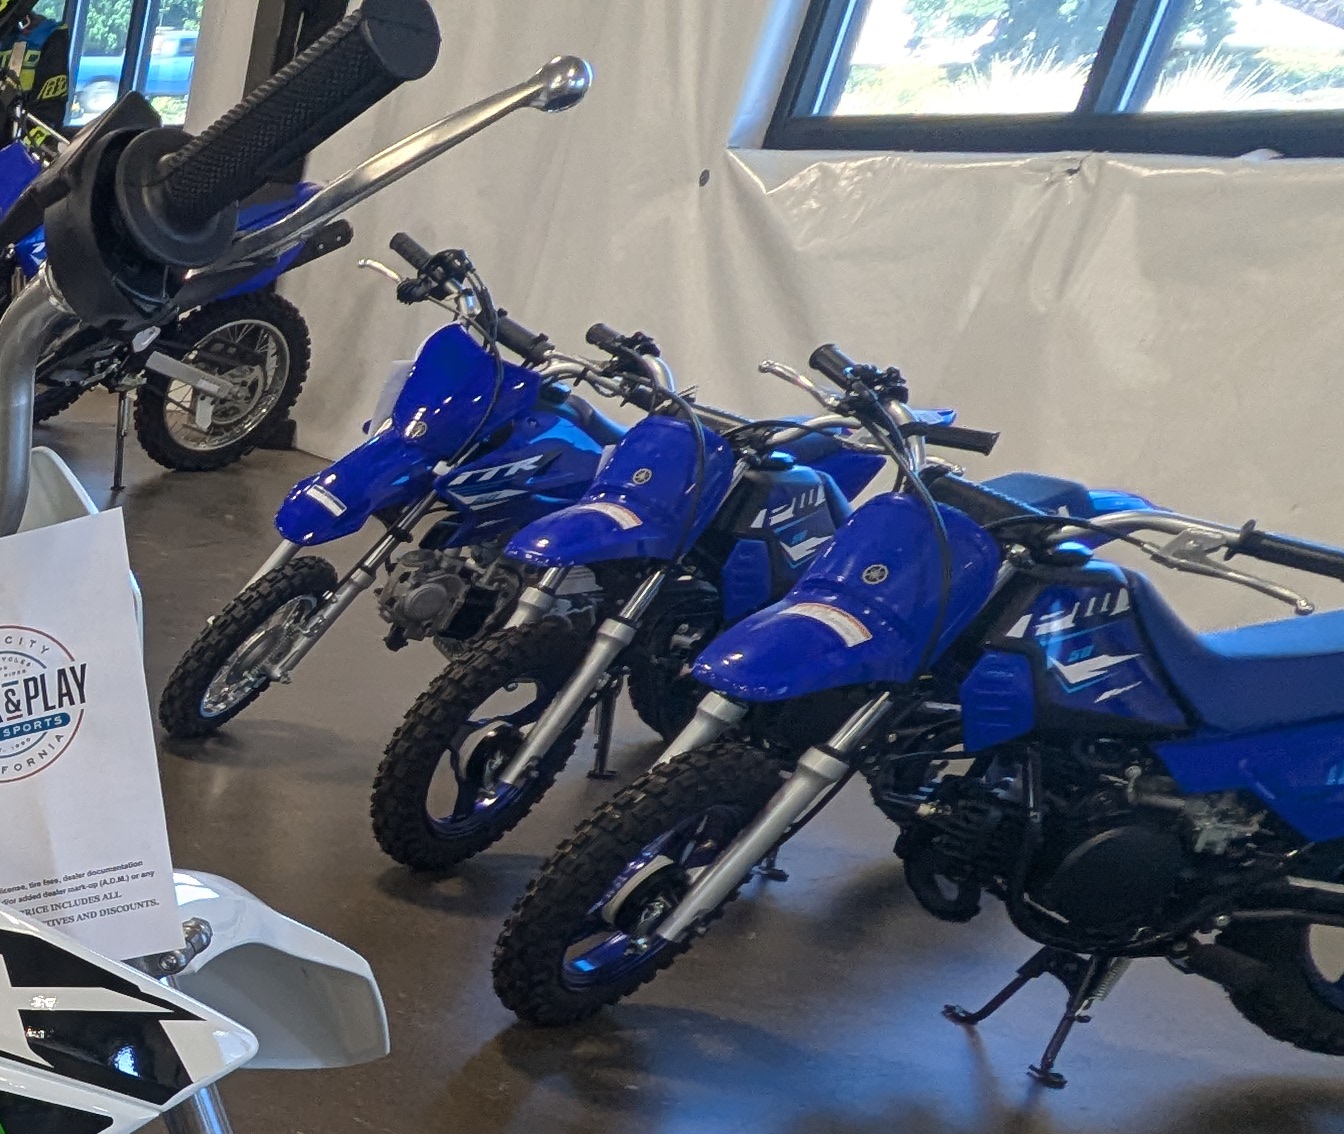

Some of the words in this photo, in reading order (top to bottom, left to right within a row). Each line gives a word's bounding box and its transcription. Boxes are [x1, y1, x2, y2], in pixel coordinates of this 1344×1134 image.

[4, 635, 50, 654] CITY
[17, 892, 43, 904] added
[42, 887, 67, 900] dealer
[67, 881, 99, 895] mark-up
[99, 874, 131, 889] (A.D.M.)
[140, 869, 156, 881] any
[28, 880, 42, 890] tire
[62, 871, 86, 883] dealer
[86, 859, 144, 878] documentation
[50, 894, 102, 912] INCLUDES
[101, 890, 124, 902] ALL
[75, 909, 98, 923] AND
[99, 898, 161, 918] DISCOUNTS.
